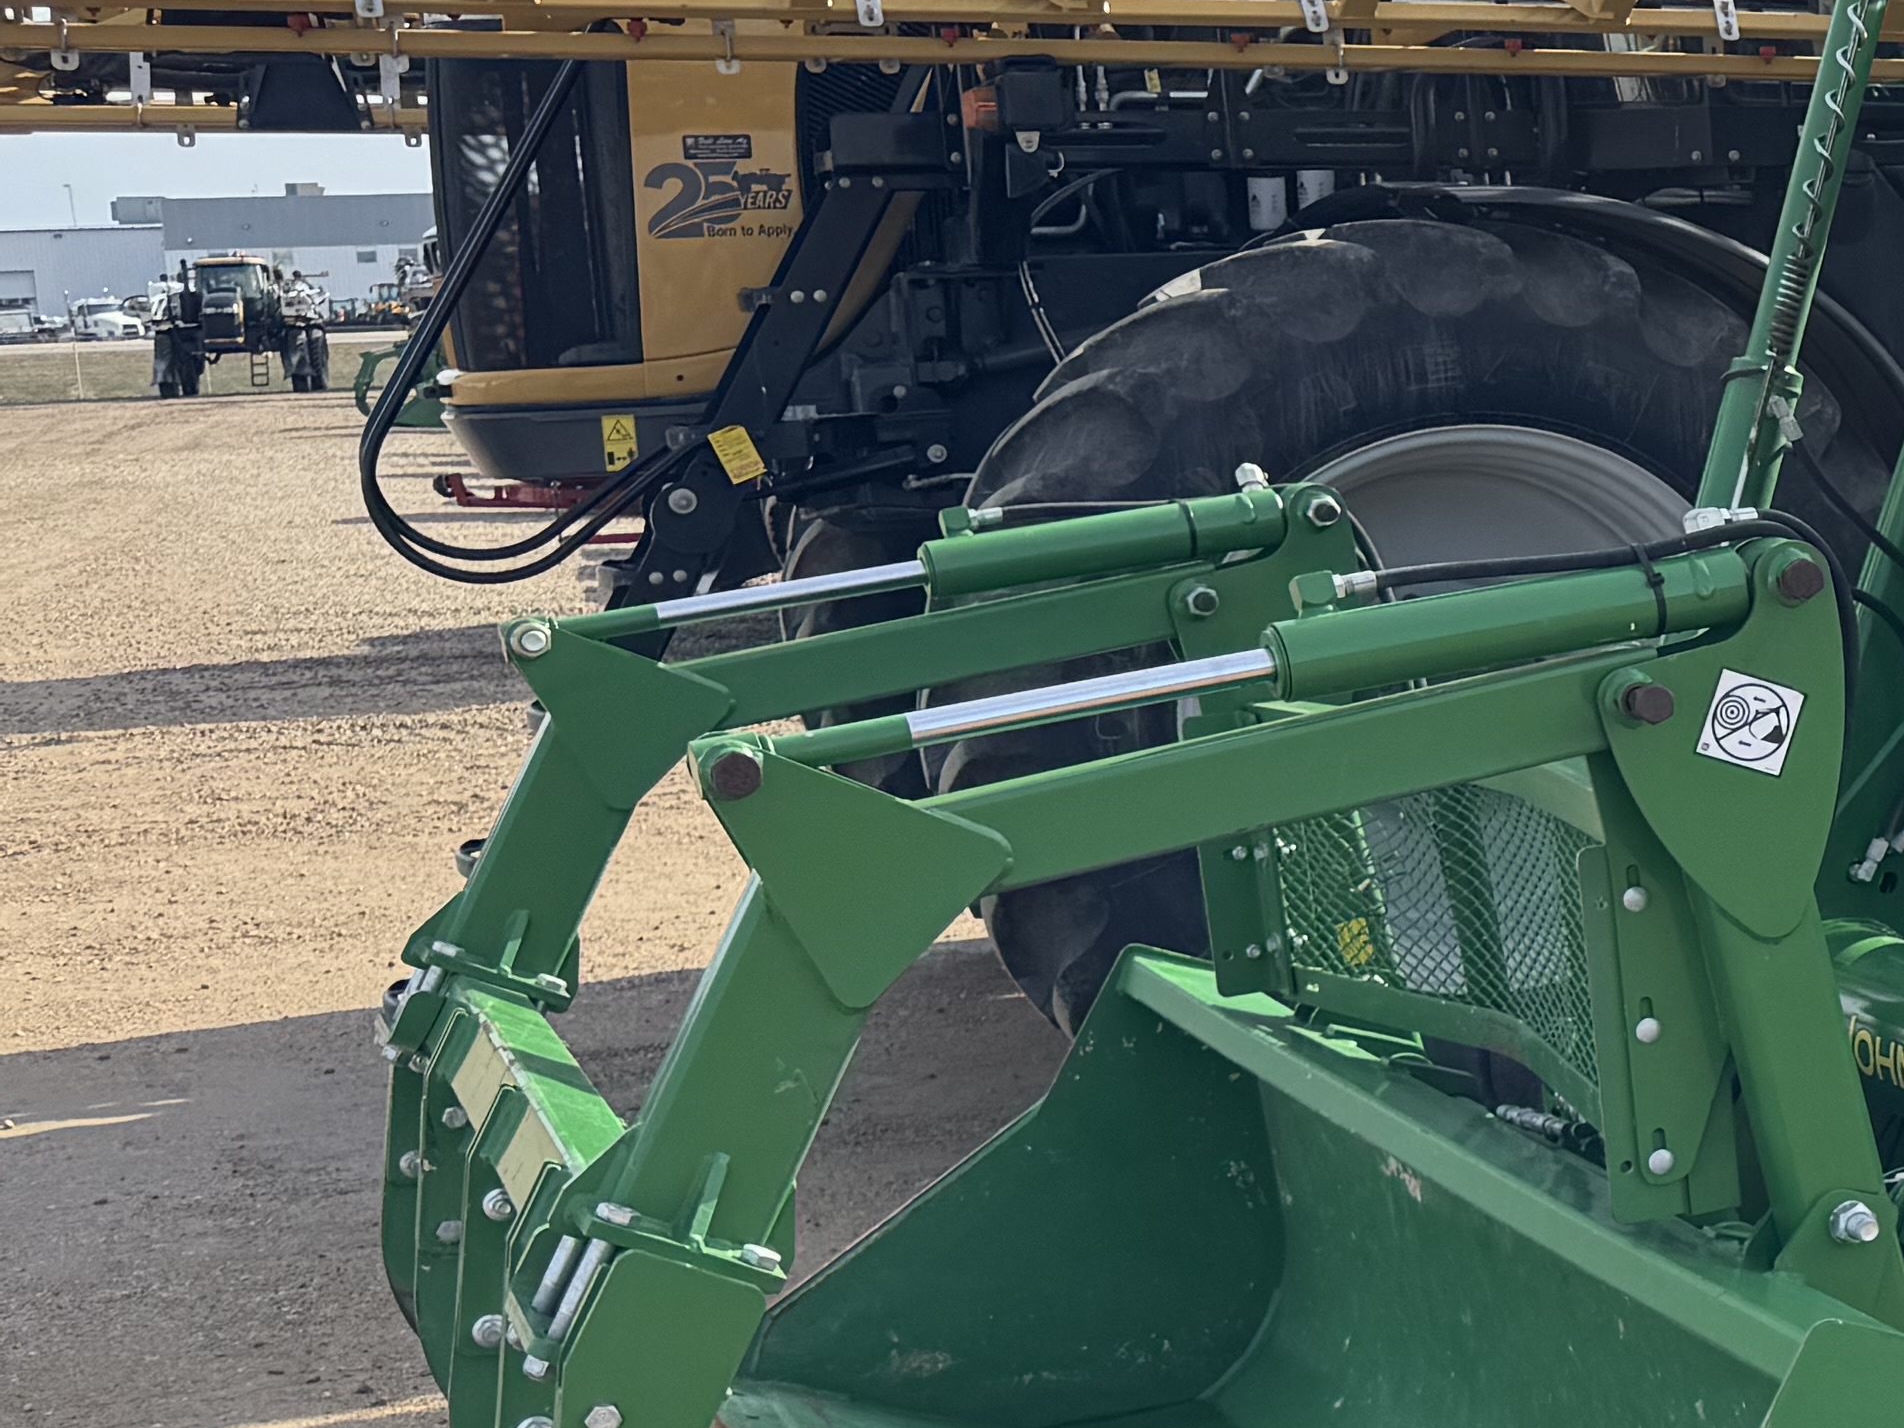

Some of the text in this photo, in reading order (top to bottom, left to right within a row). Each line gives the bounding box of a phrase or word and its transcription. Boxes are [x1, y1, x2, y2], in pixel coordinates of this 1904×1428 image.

[738, 191, 788, 209] YEARS
[707, 224, 794, 239] Born to Apply
